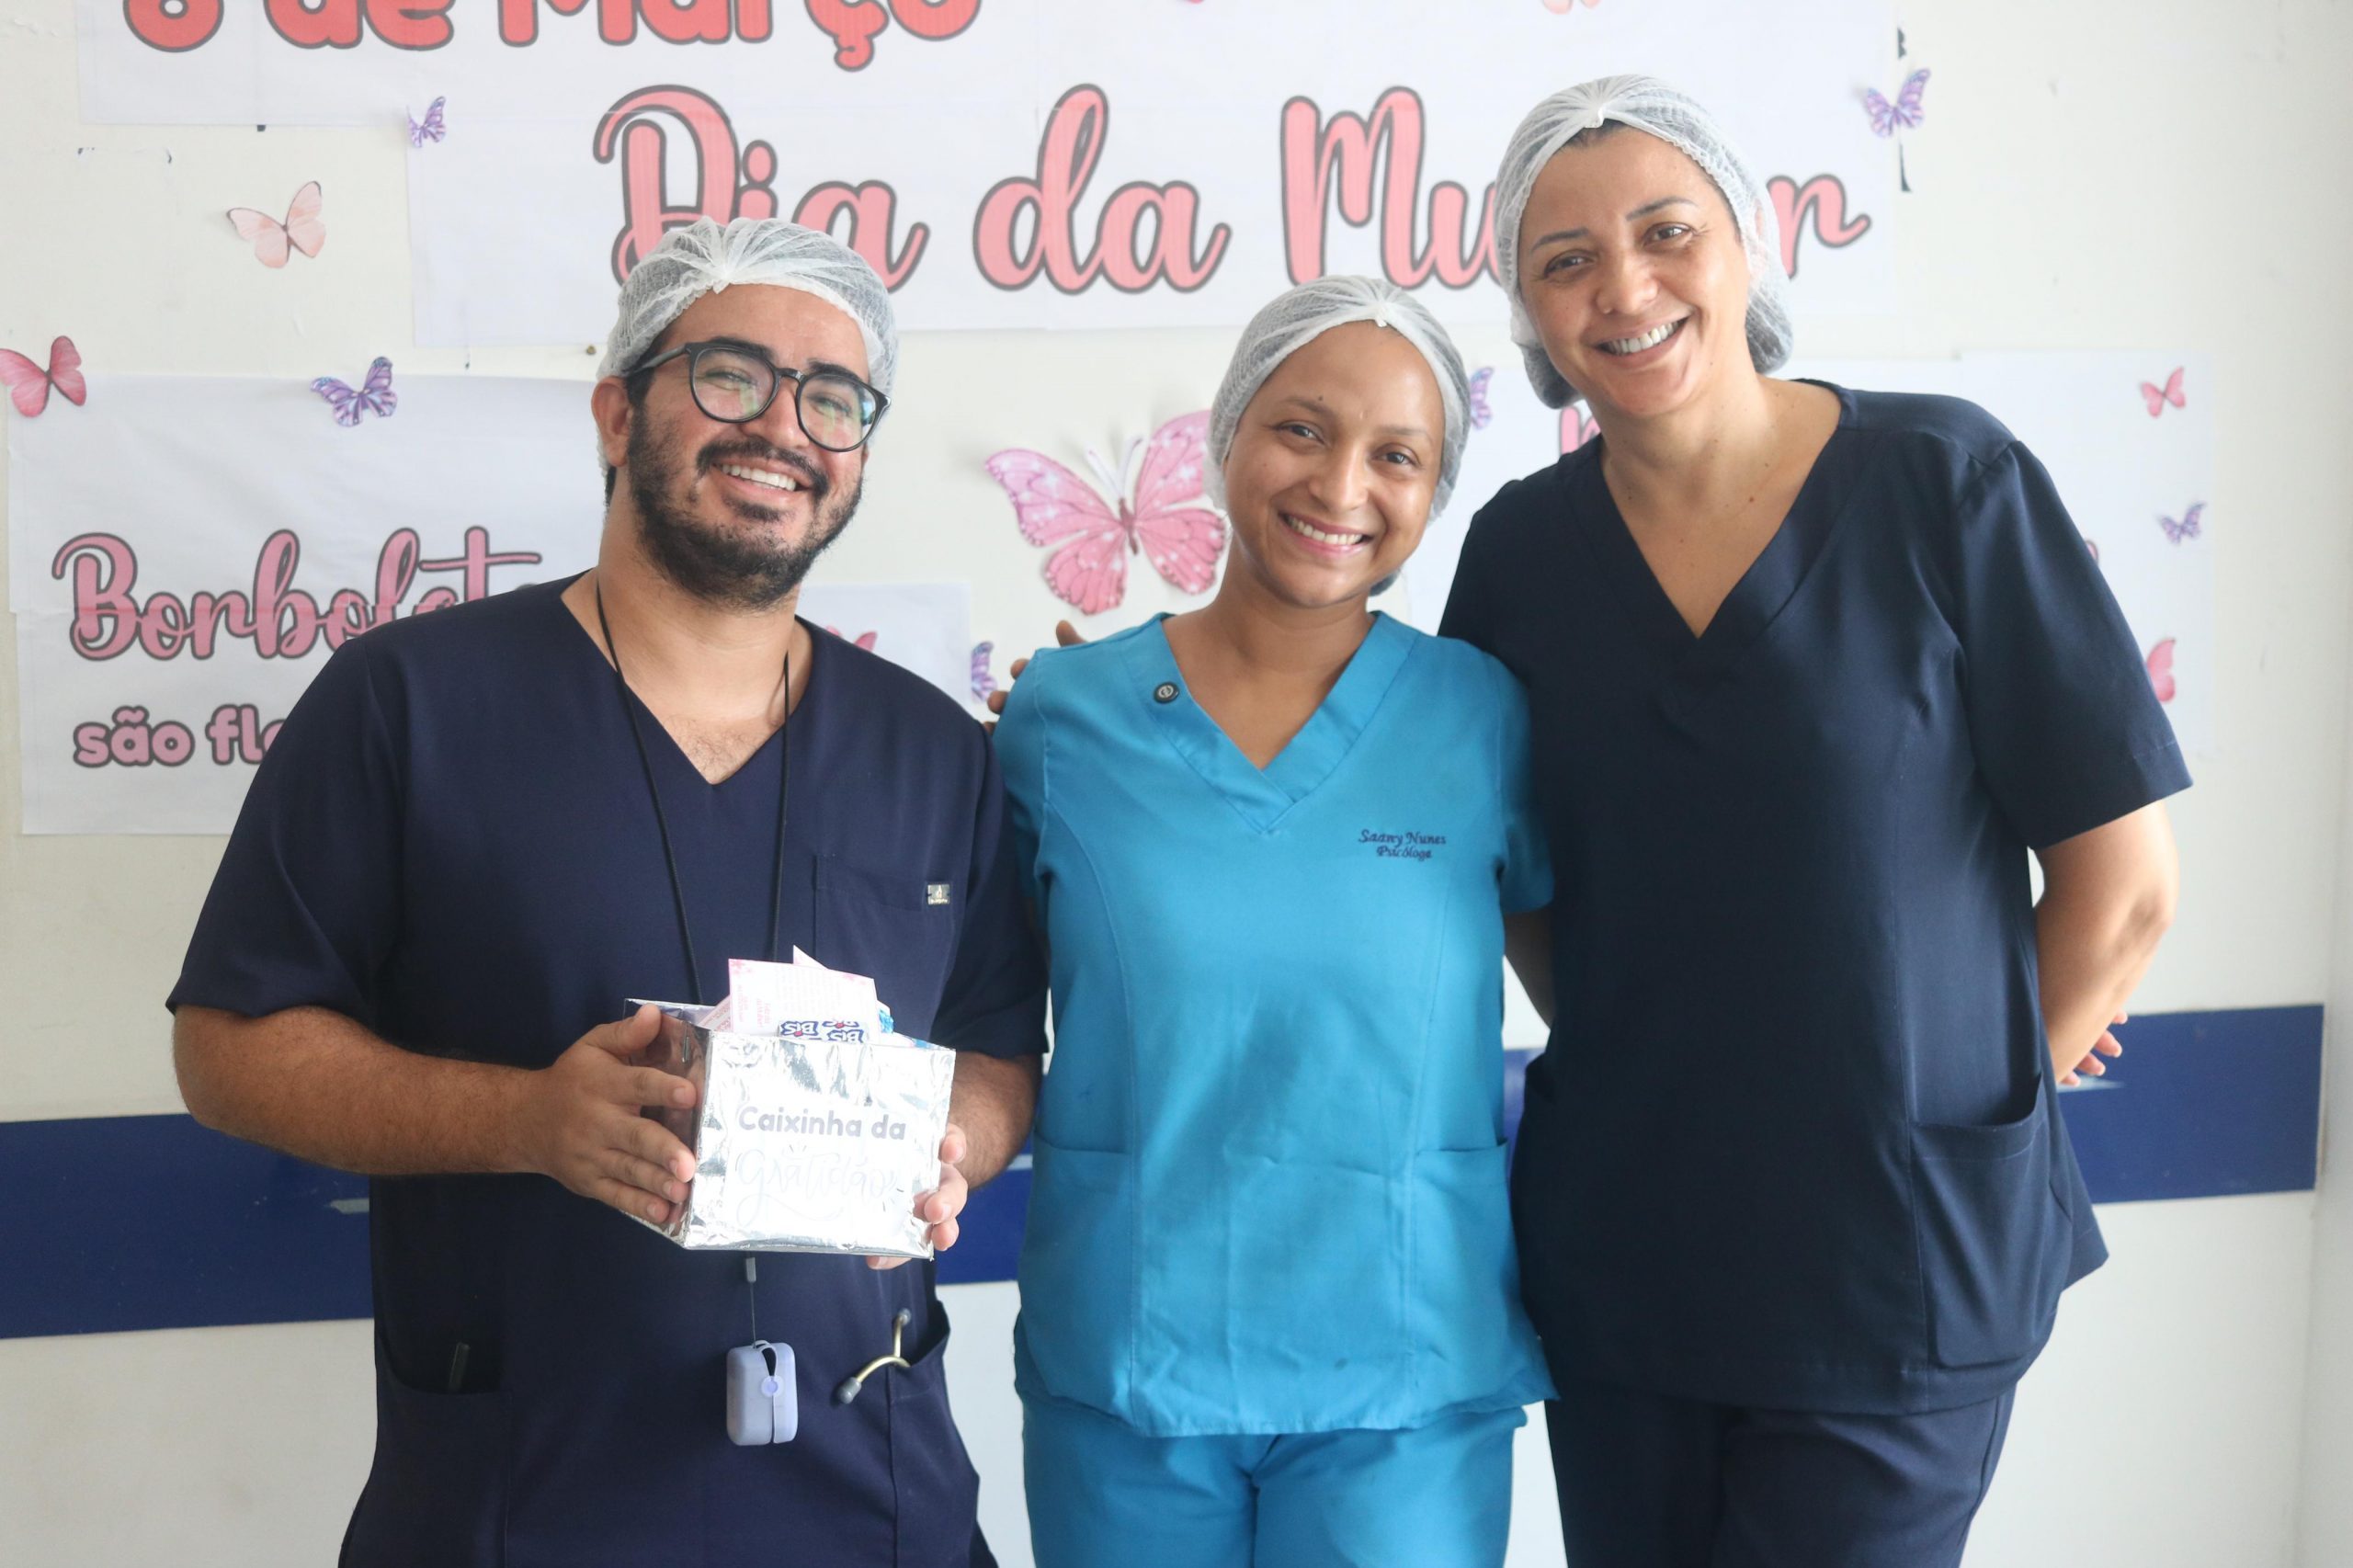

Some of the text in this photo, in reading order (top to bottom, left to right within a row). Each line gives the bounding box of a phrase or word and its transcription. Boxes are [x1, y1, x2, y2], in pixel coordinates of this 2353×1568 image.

[593, 84, 930, 293] Dia
[973, 83, 1233, 294] da
[74, 706, 195, 767] são
[1405, 832, 1447, 845] Nunes
[738, 1107, 906, 1140] Caixinha da
